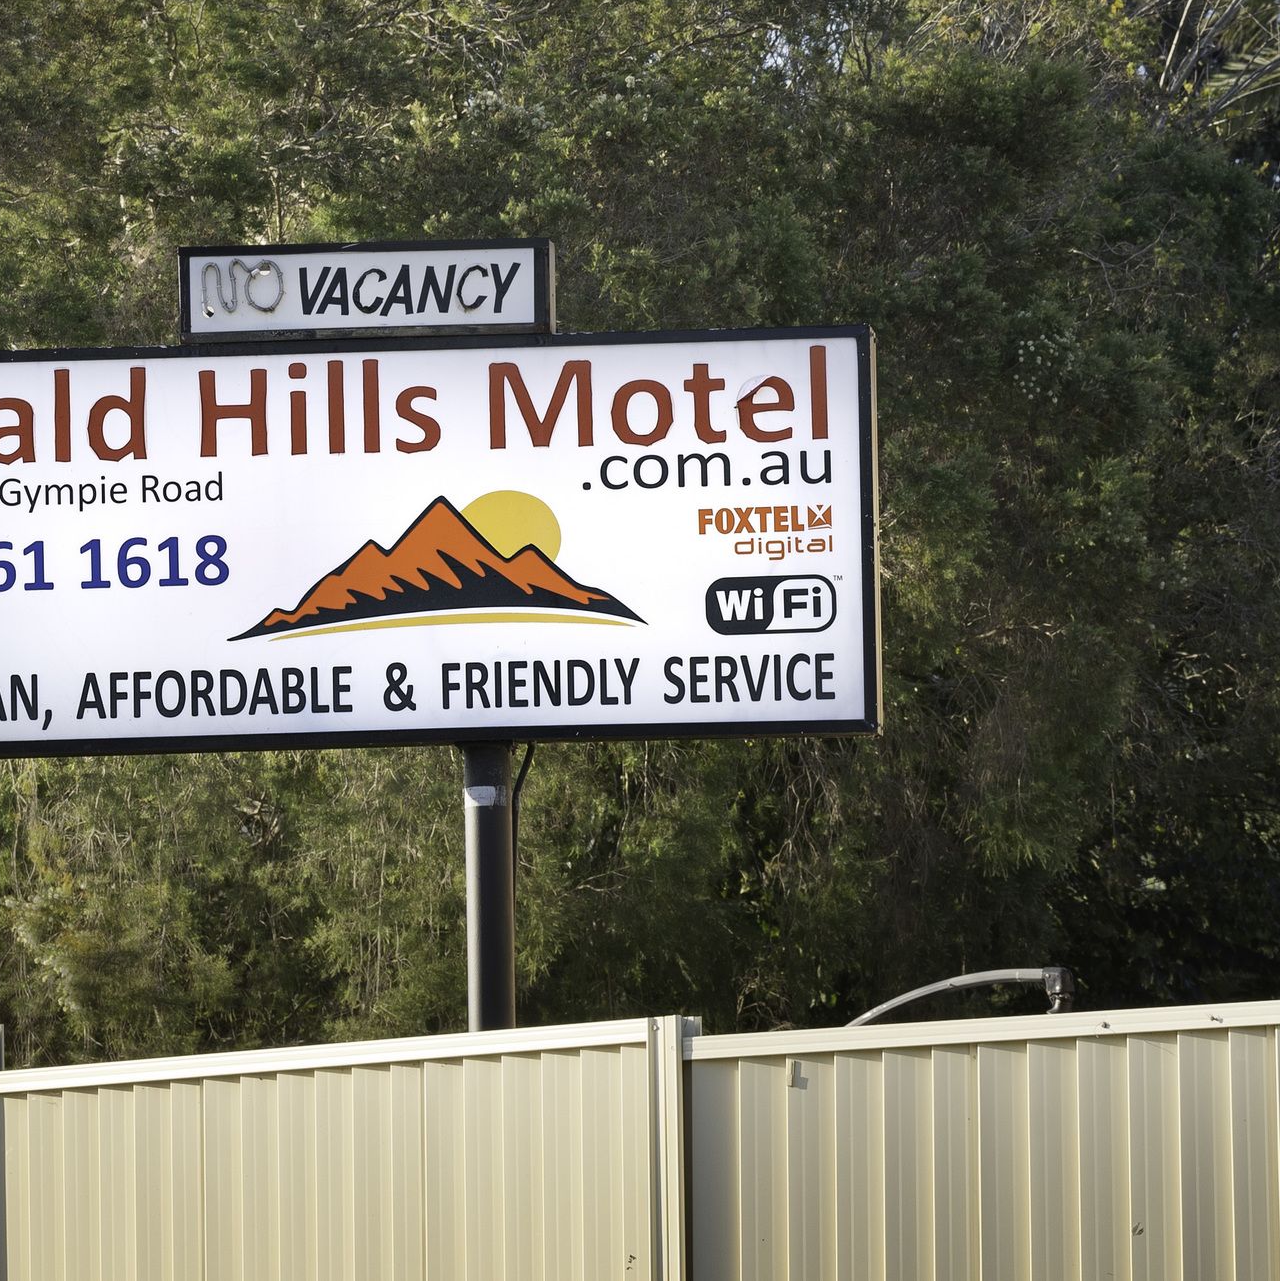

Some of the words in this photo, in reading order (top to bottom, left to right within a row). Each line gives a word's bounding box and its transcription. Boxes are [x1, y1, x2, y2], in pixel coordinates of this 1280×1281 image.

[298, 262, 522, 317] VACANCY
[198, 358, 442, 458] Hills
[488, 344, 829, 450] Motel
[141, 471, 224, 504] Road
[581, 449, 833, 491] .com.au
[698, 505, 805, 536] FOXTEL
[79, 534, 230, 590] 1618
[734, 535, 833, 561] digital
[76, 665, 354, 719] AFFORDABLE
[383, 662, 417, 712] &
[442, 657, 640, 710] FRIENDLY
[663, 653, 836, 704] SERVICE
